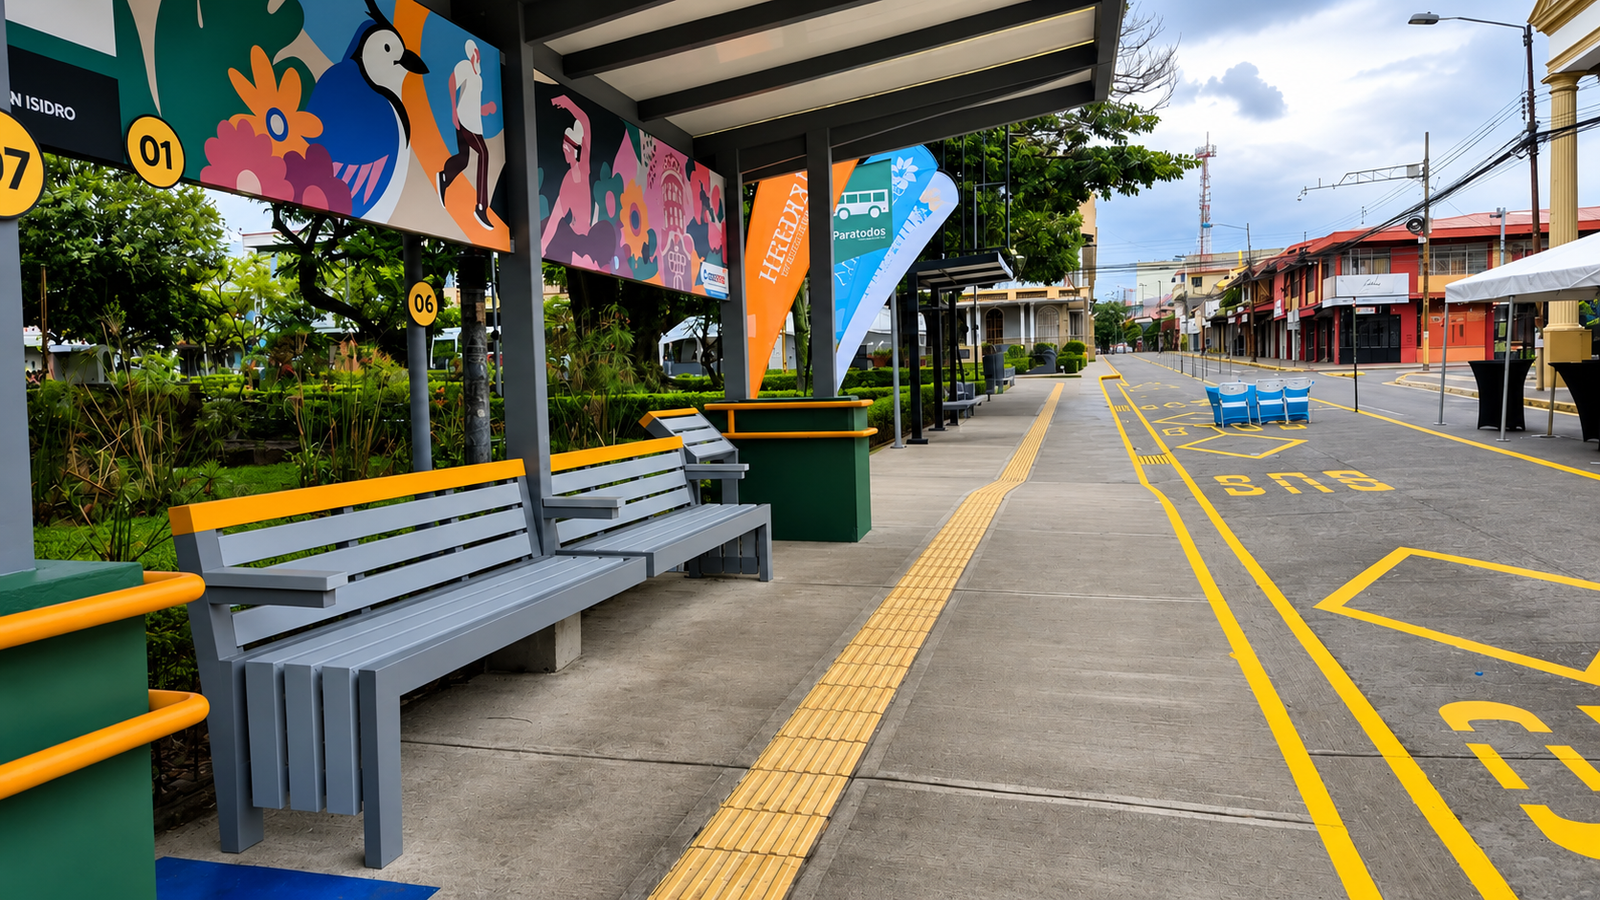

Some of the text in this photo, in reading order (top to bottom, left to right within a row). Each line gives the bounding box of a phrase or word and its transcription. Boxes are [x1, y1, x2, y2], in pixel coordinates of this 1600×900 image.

[25, 95, 76, 121] ISIDRO
[139, 134, 173, 170] 01
[0, 146, 30, 190] 7
[833, 227, 886, 240] Paratodos
[414, 293, 434, 314] 06
